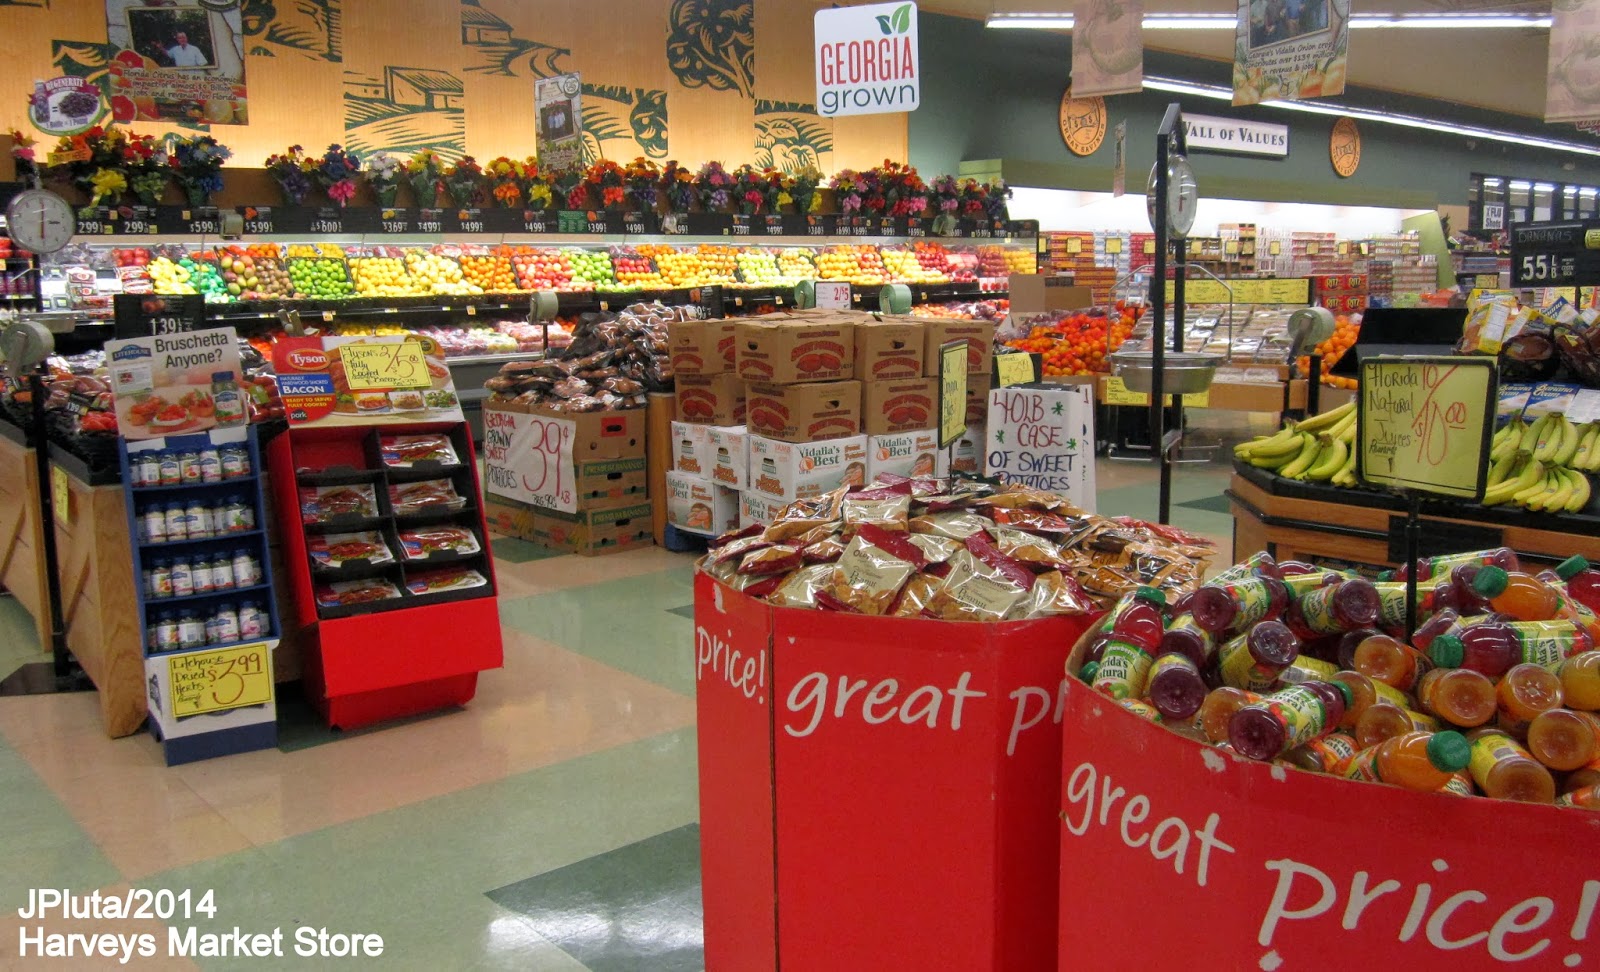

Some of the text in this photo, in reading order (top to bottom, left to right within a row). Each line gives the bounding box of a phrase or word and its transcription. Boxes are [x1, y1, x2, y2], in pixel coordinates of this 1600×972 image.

[1275, 46, 1295, 55] Vidalia
[1297, 44, 1316, 52] Onion
[820, 36, 914, 86] GEORGIA
[822, 84, 915, 114] grown
[1220, 128, 1235, 141] OF
[1239, 127, 1285, 146] VALUES
[155, 333, 229, 354] Bruschetta
[165, 349, 223, 369] Anyone?
[290, 353, 327, 367] Tyson
[282, 385, 325, 394] BACON
[877, 436, 913, 449] Vidalia's
[1017, 423, 1064, 449] CASE
[796, 445, 840, 459] Vidalia's
[813, 454, 840, 467] Best
[889, 445, 912, 457] Best
[988, 450, 1078, 473] OF SWEET
[992, 470, 1071, 491] POTATOES
[697, 625, 766, 705] price!
[784, 671, 988, 738] great
[1066, 762, 1236, 887] great
[1257, 858, 1600, 968] price!
